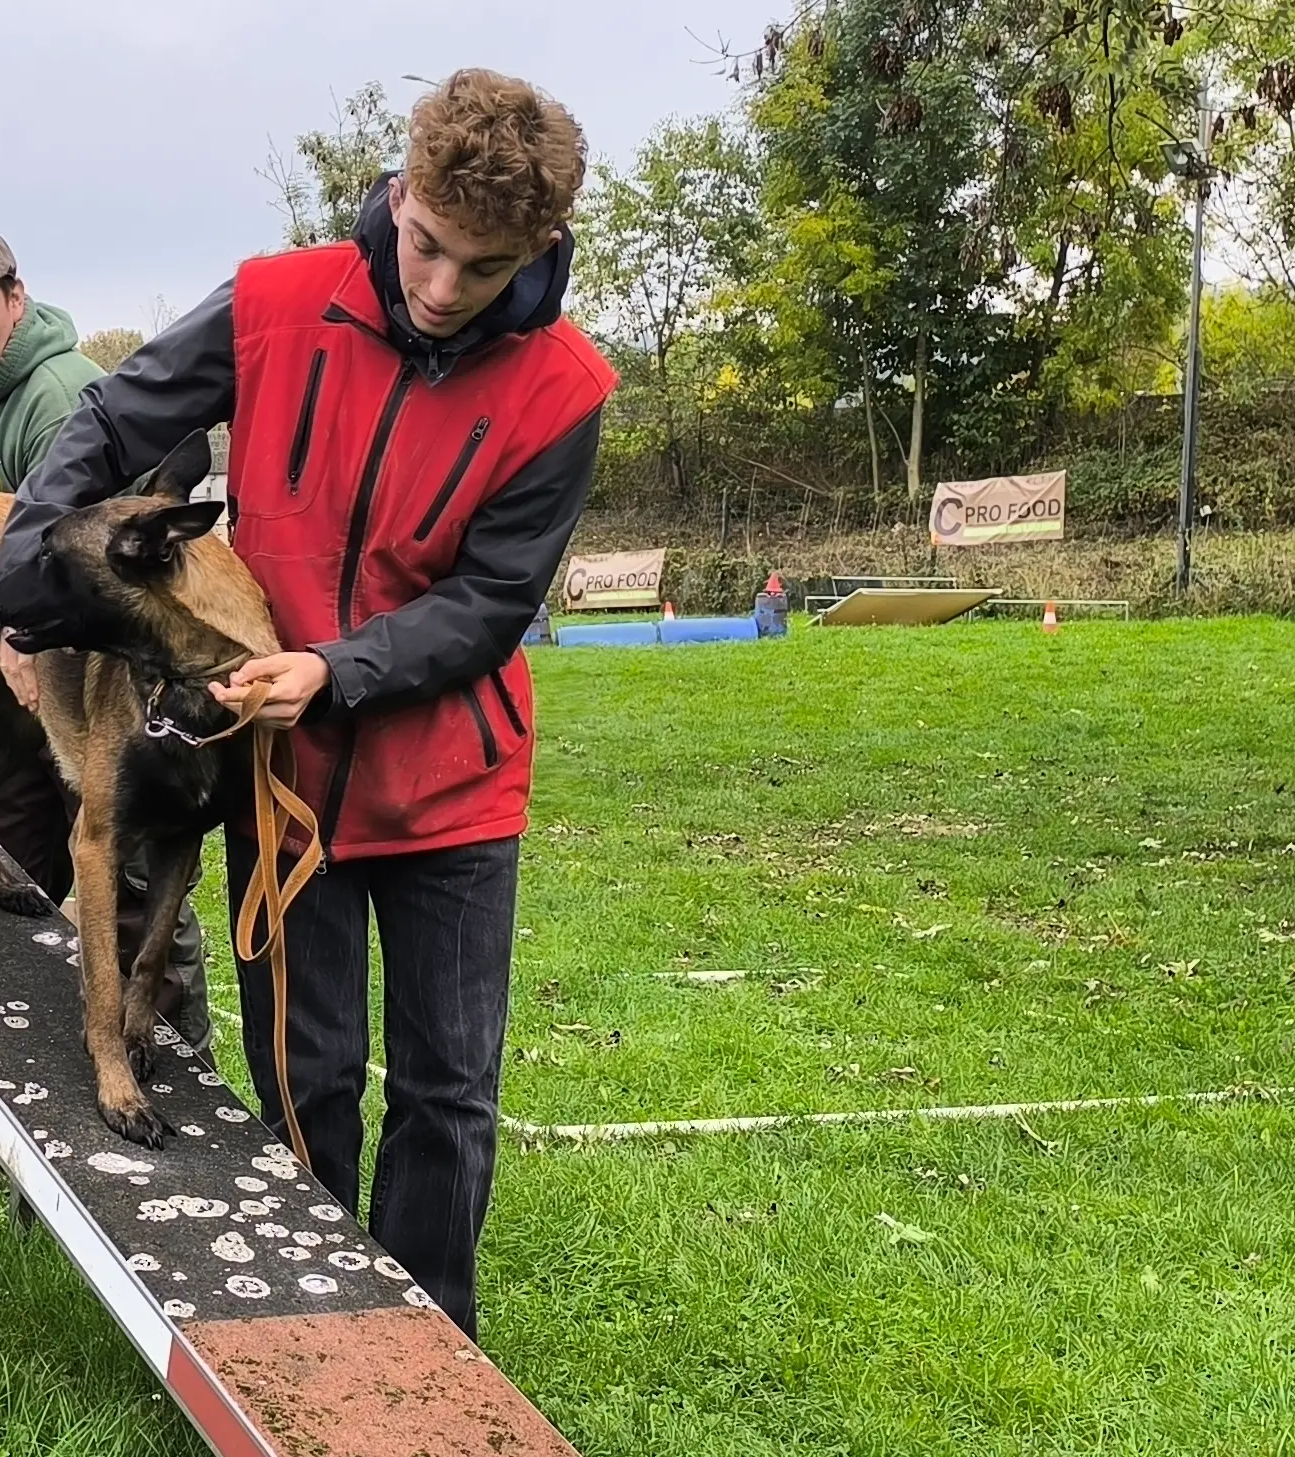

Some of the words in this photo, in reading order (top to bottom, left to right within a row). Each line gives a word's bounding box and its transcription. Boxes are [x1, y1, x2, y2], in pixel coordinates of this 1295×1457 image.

[934, 497, 963, 536] C
[965, 504, 1002, 523] PRO
[1007, 498, 1061, 520] FOOD
[566, 568, 587, 602] C
[586, 574, 614, 590] PRO
[617, 572, 658, 588] FOOD
